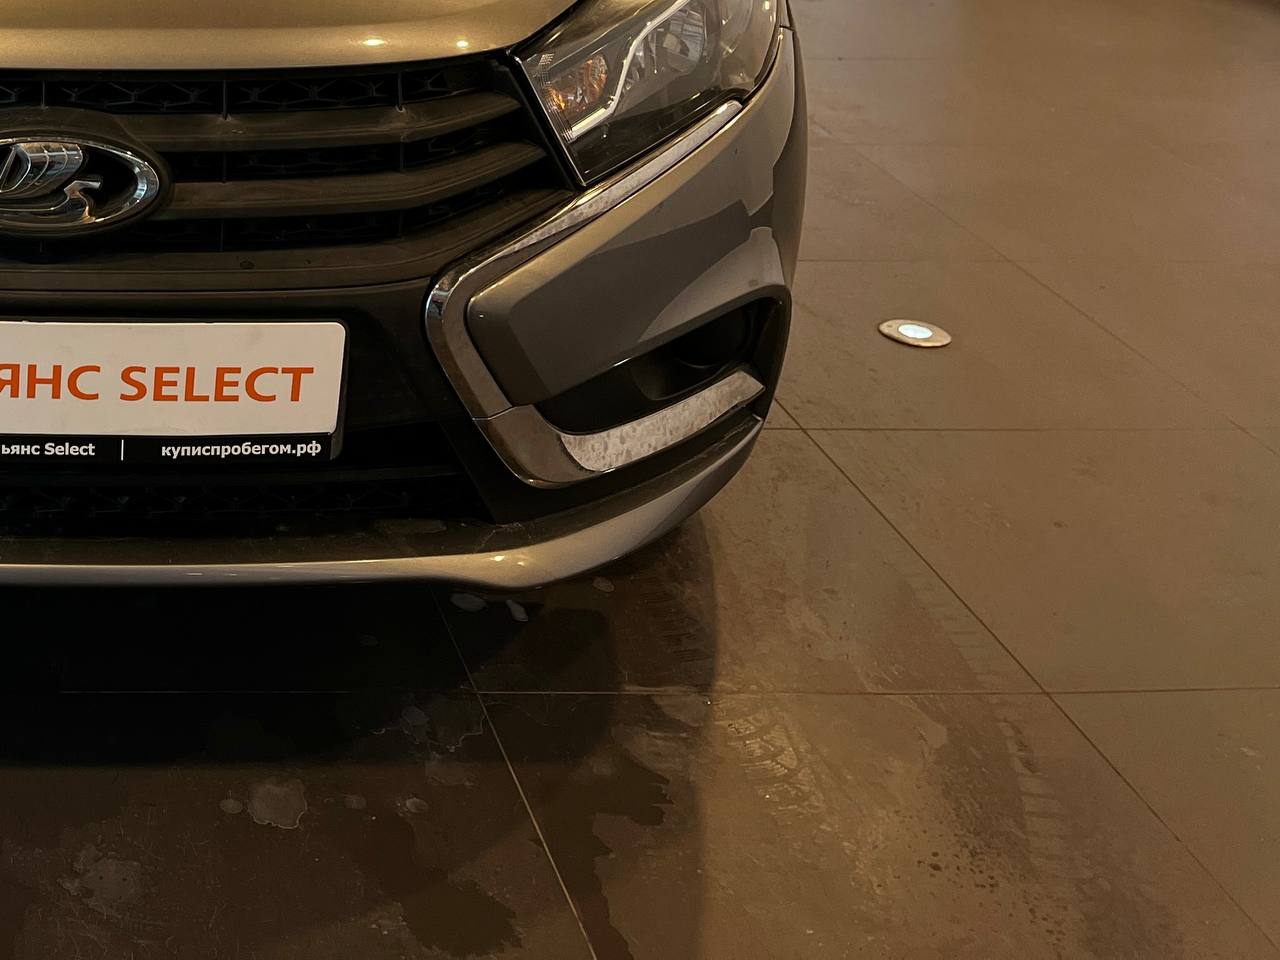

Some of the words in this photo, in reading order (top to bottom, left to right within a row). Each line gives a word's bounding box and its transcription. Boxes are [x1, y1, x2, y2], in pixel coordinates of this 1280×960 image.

[119, 365, 314, 402] SELECT
[44, 442, 96, 456] Select
[161, 441, 321, 459] куписпробегом.рф
